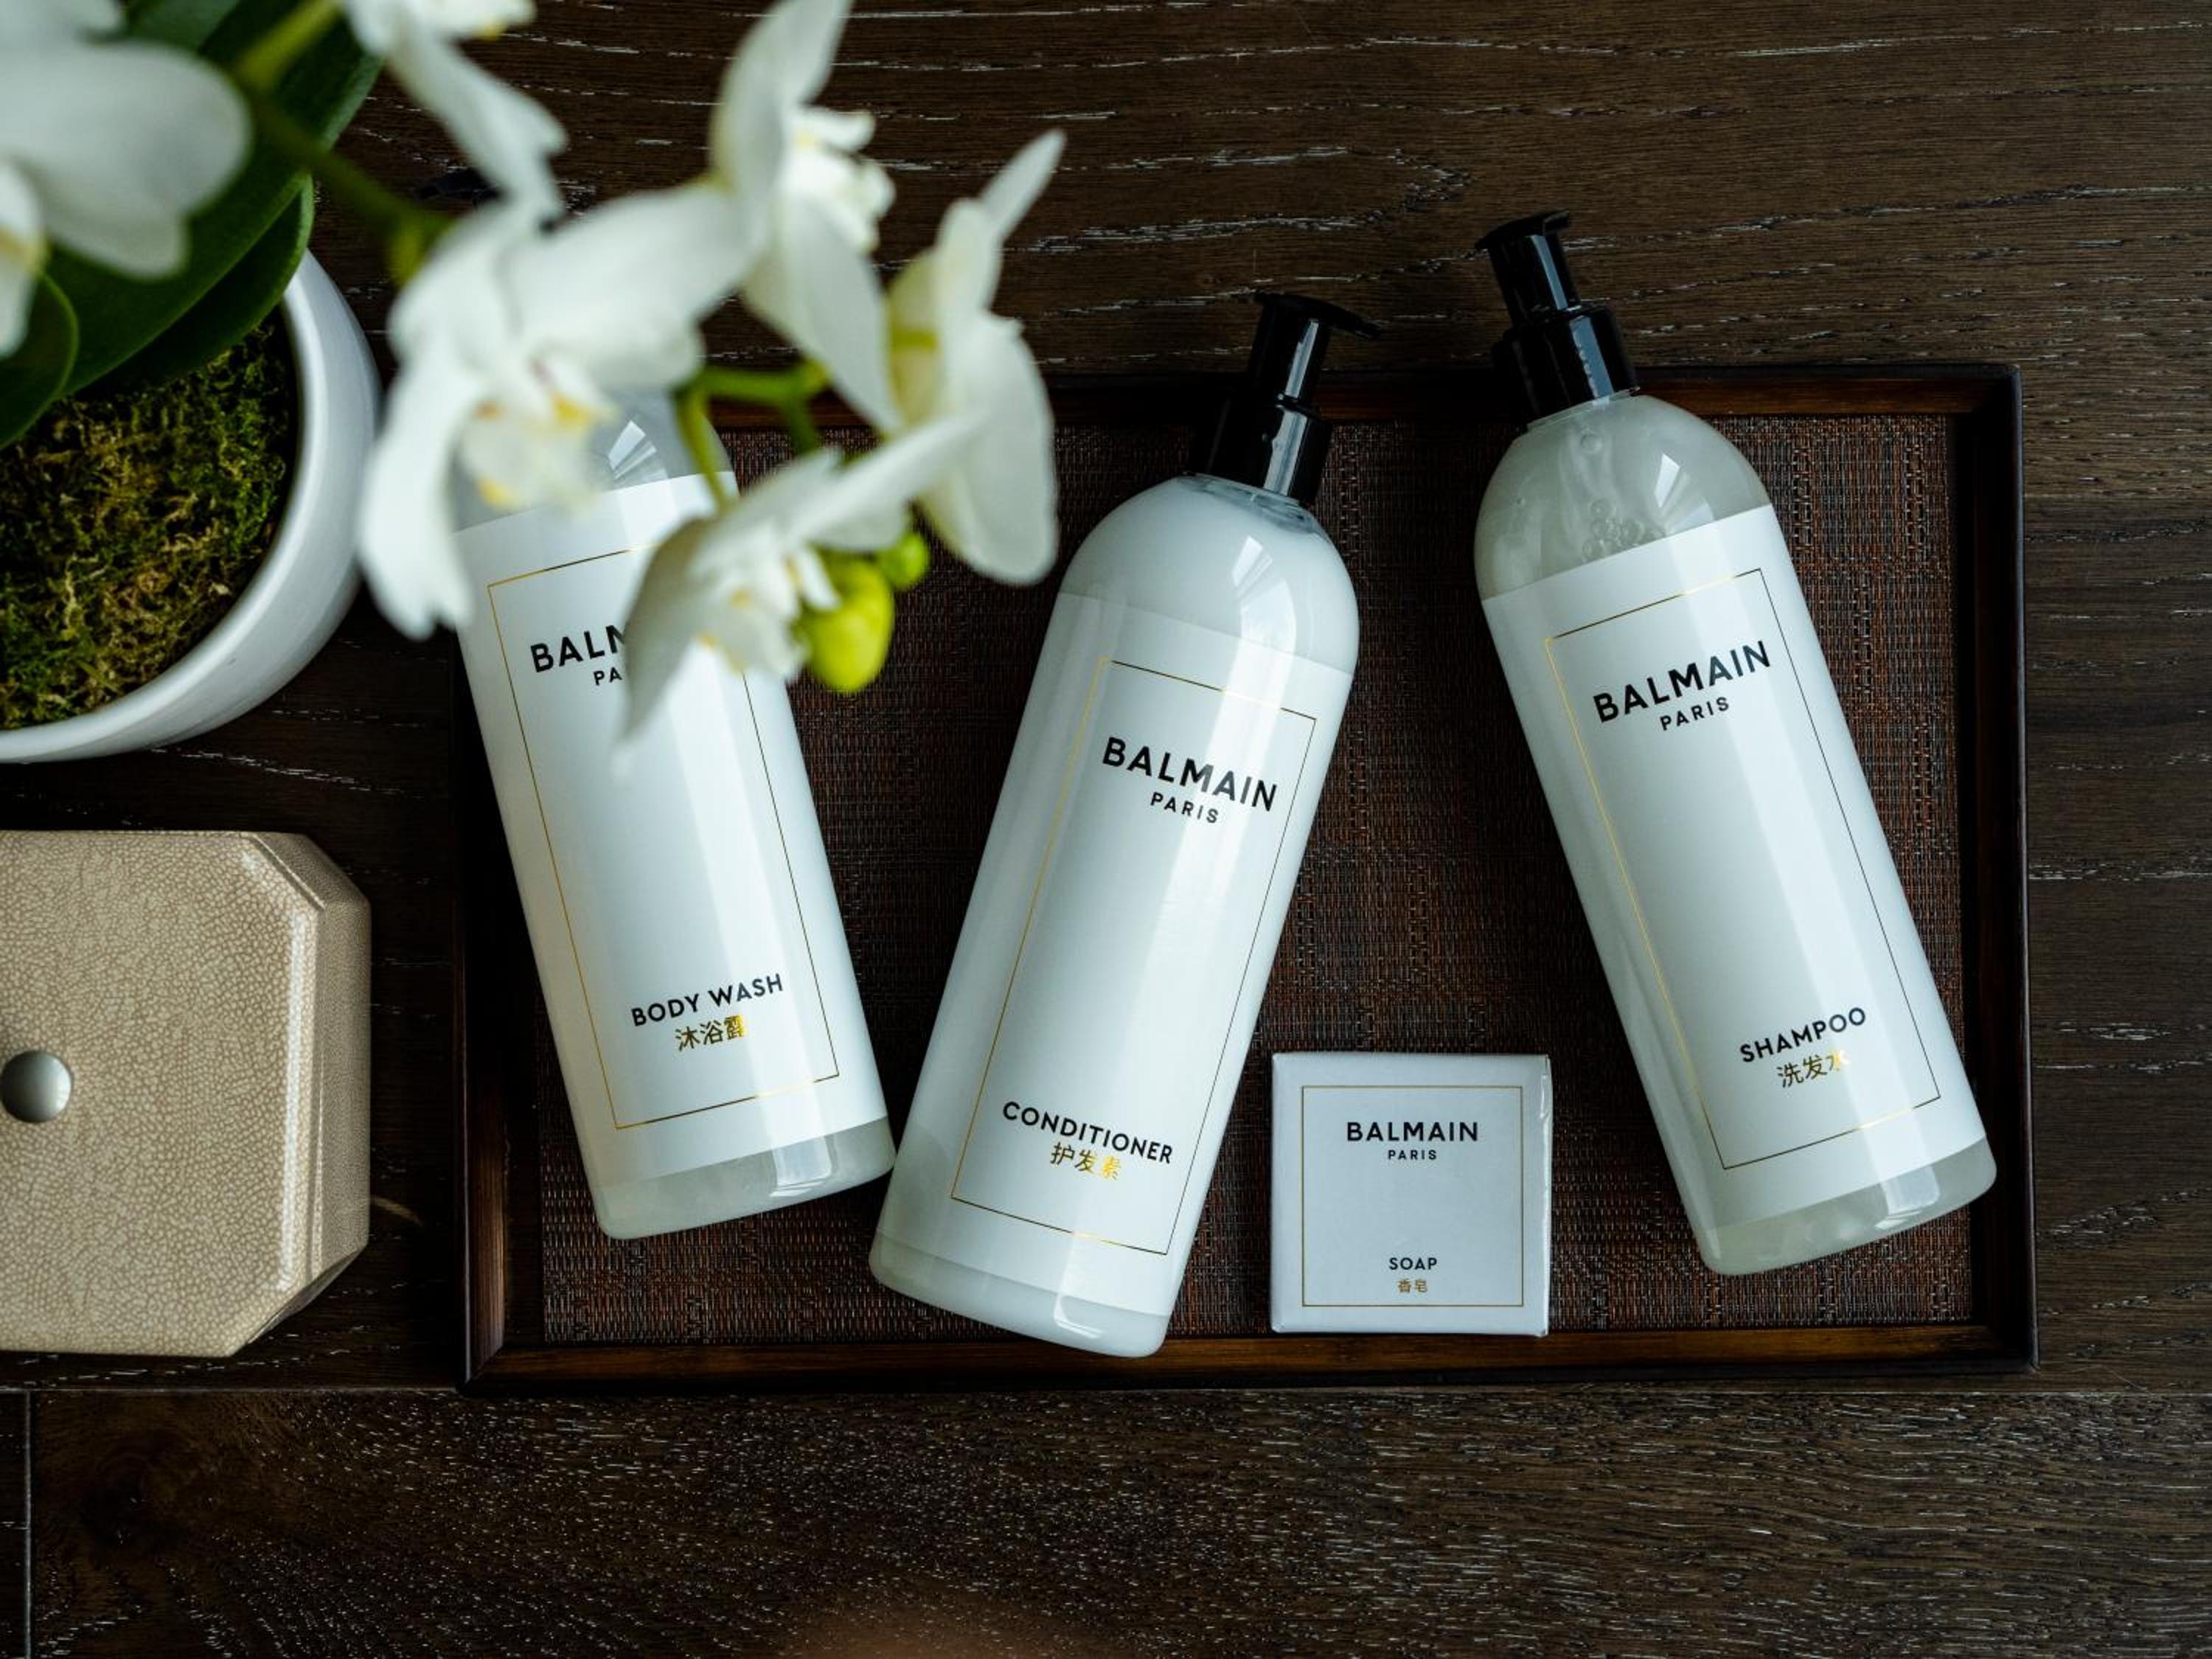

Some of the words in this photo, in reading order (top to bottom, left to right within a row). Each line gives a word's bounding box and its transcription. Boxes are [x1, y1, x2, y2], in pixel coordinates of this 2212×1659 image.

[530, 625, 625, 673] BALM
[1593, 640, 1771, 723] BALMAIN
[1660, 697, 1730, 731] PARIS
[1102, 736, 1277, 812] BALMAIN
[1150, 791, 1220, 824] PARIS
[630, 992, 700, 1027] BODY
[708, 973, 783, 1007] WASH
[675, 1014, 746, 1052] 沐浴露
[1739, 1006, 1866, 1063] SHAMPOO
[1002, 1101, 1173, 1164] CONDITIONER
[1346, 1121, 1478, 1142] BALMAIN
[1388, 1150, 1437, 1161] PARIS
[1388, 1256, 1438, 1270] SOAP
[1397, 1279, 1428, 1293] 香皂
